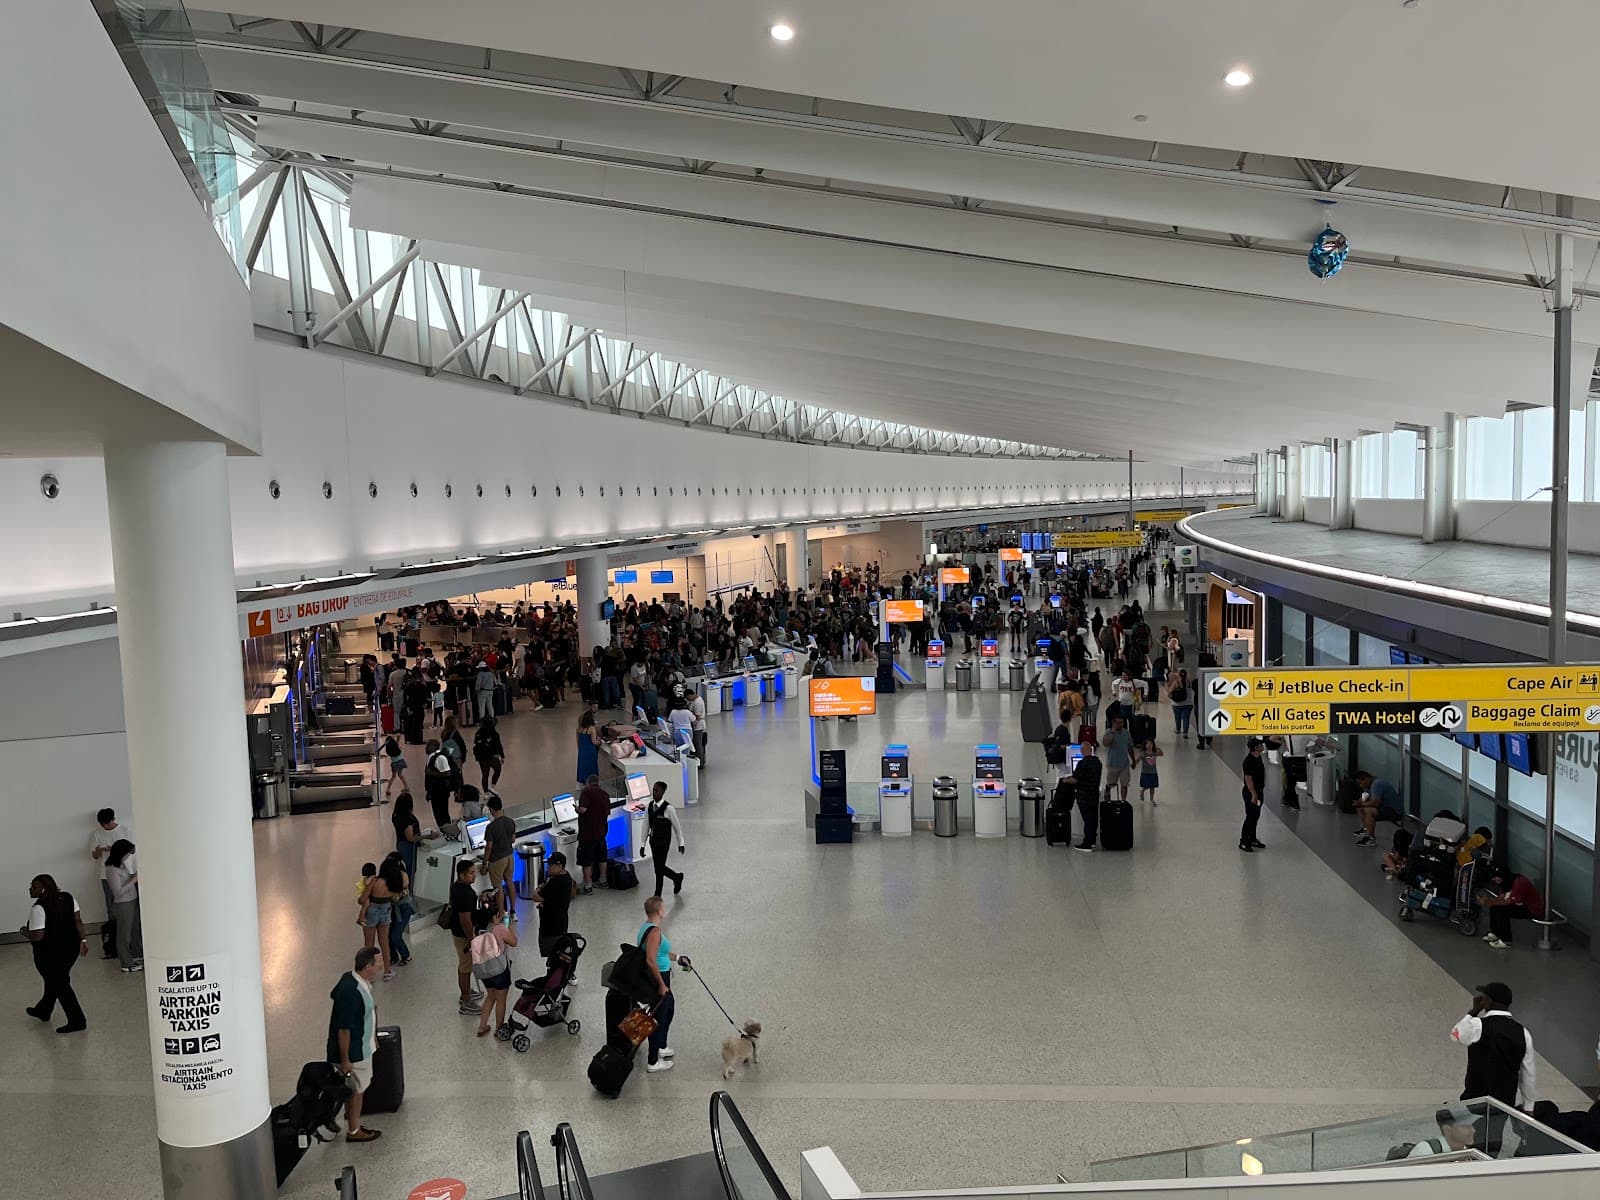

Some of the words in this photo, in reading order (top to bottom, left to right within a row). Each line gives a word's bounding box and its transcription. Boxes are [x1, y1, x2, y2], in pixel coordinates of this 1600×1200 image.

[552, 582, 577, 592] jetBlue
[297, 602, 319, 618] BAG
[321, 595, 349, 614] DROP
[1279, 680, 1334, 694] JetBlue
[1338, 679, 1404, 694] Check-in
[1507, 677, 1545, 693] Cape
[1550, 675, 1572, 690] Air
[1261, 707, 1281, 721] All
[1285, 708, 1326, 721] Gates
[1336, 711, 1371, 726] TWA
[1375, 710, 1415, 725] Hotel
[1471, 705, 1536, 721] Baggage
[1541, 704, 1580, 718] Claim
[1551, 719, 1581, 728] equipaje
[158, 986, 195, 994] ESCALATOR
[197, 984, 207, 992] UP
[159, 991, 221, 1007] AIRTRAIN
[161, 1004, 220, 1020] PARKING
[170, 1018, 210, 1032] TAXIS
[161, 1068, 233, 1084] ESTACIONAMIENTO
[174, 1066, 213, 1076] AIRTRAIN
[183, 1082, 207, 1091] TAXIS
